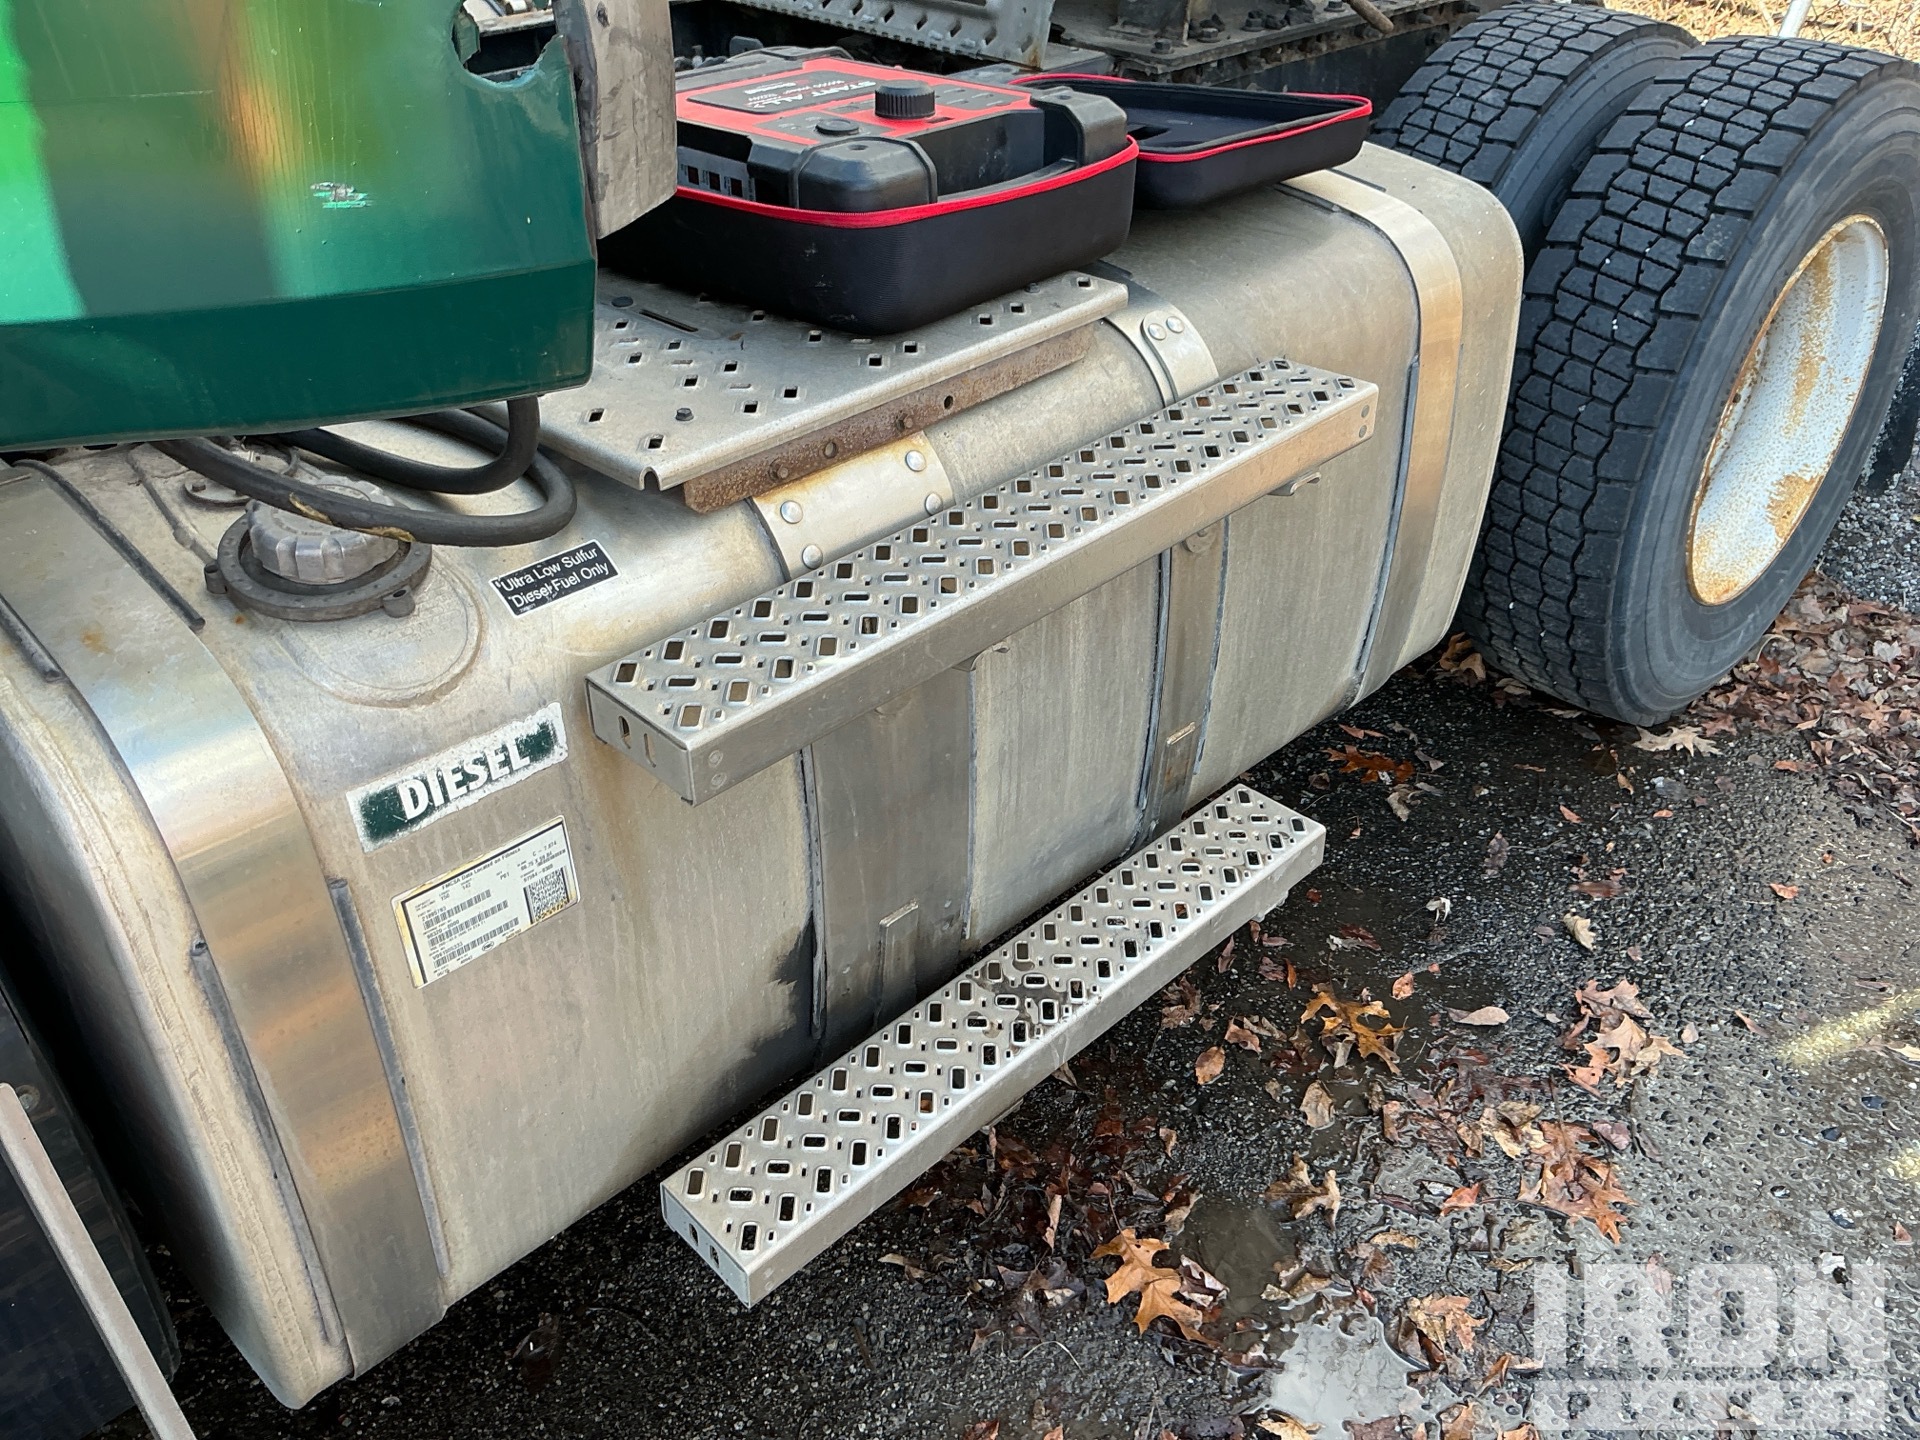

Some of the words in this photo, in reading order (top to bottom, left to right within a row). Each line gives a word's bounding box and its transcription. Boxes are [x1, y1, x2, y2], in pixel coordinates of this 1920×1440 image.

[500, 575, 535, 592] Ultra
[533, 562, 561, 580] Low
[561, 547, 598, 569] Sulfur
[511, 584, 552, 608] Diesel
[551, 572, 581, 592] Fuel
[580, 562, 610, 580] Only
[396, 738, 530, 820] DIESEL
[441, 877, 460, 890] FMCSA
[461, 870, 473, 880] Data
[473, 860, 493, 874] Located
